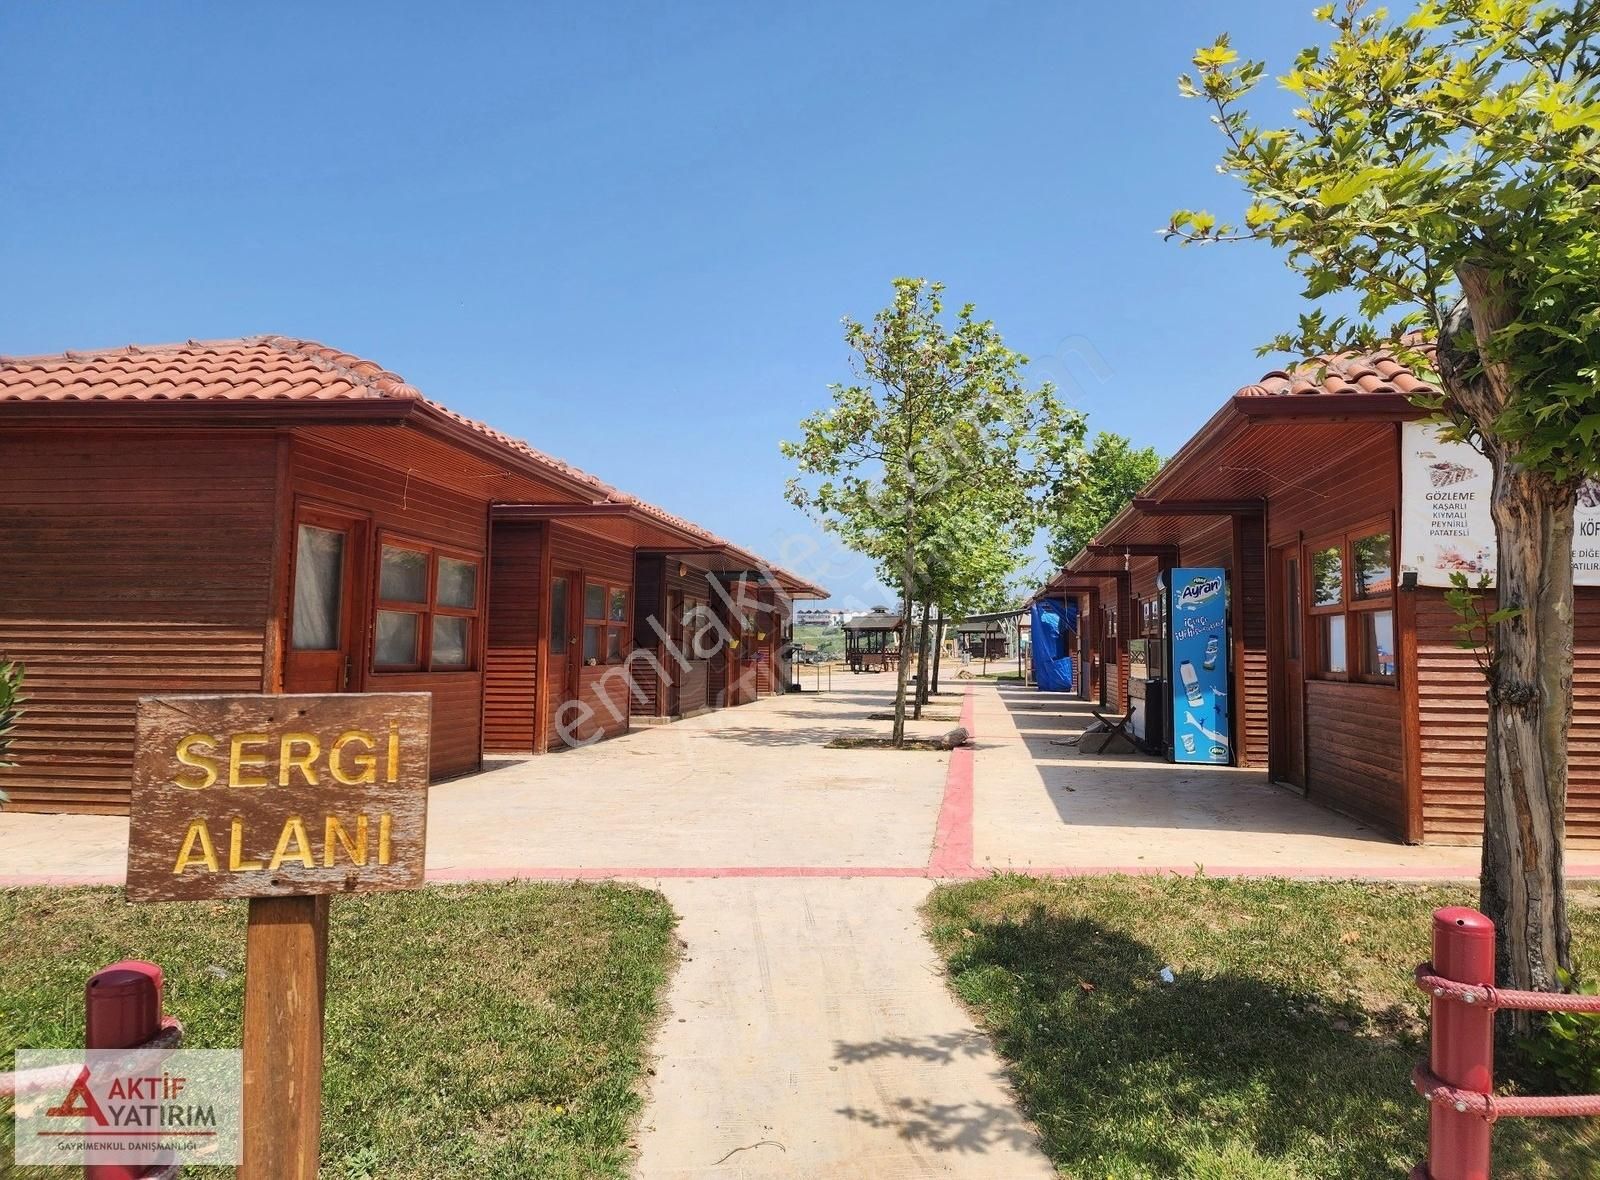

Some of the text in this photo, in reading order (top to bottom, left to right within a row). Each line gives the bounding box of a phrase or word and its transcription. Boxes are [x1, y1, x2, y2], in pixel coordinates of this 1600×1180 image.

[1425, 490, 1476, 501] GÖZLEME
[1432, 503, 1467, 511] KAŞARLI
[1431, 519, 1468, 528] PEYNİRLİ
[1429, 528, 1470, 537] PATATESLİ
[1571, 562, 1600, 571] ATILIR
[1182, 580, 1219, 599] Ayran
[174, 719, 399, 790] SERGİ
[174, 813, 391, 874] ALANI
